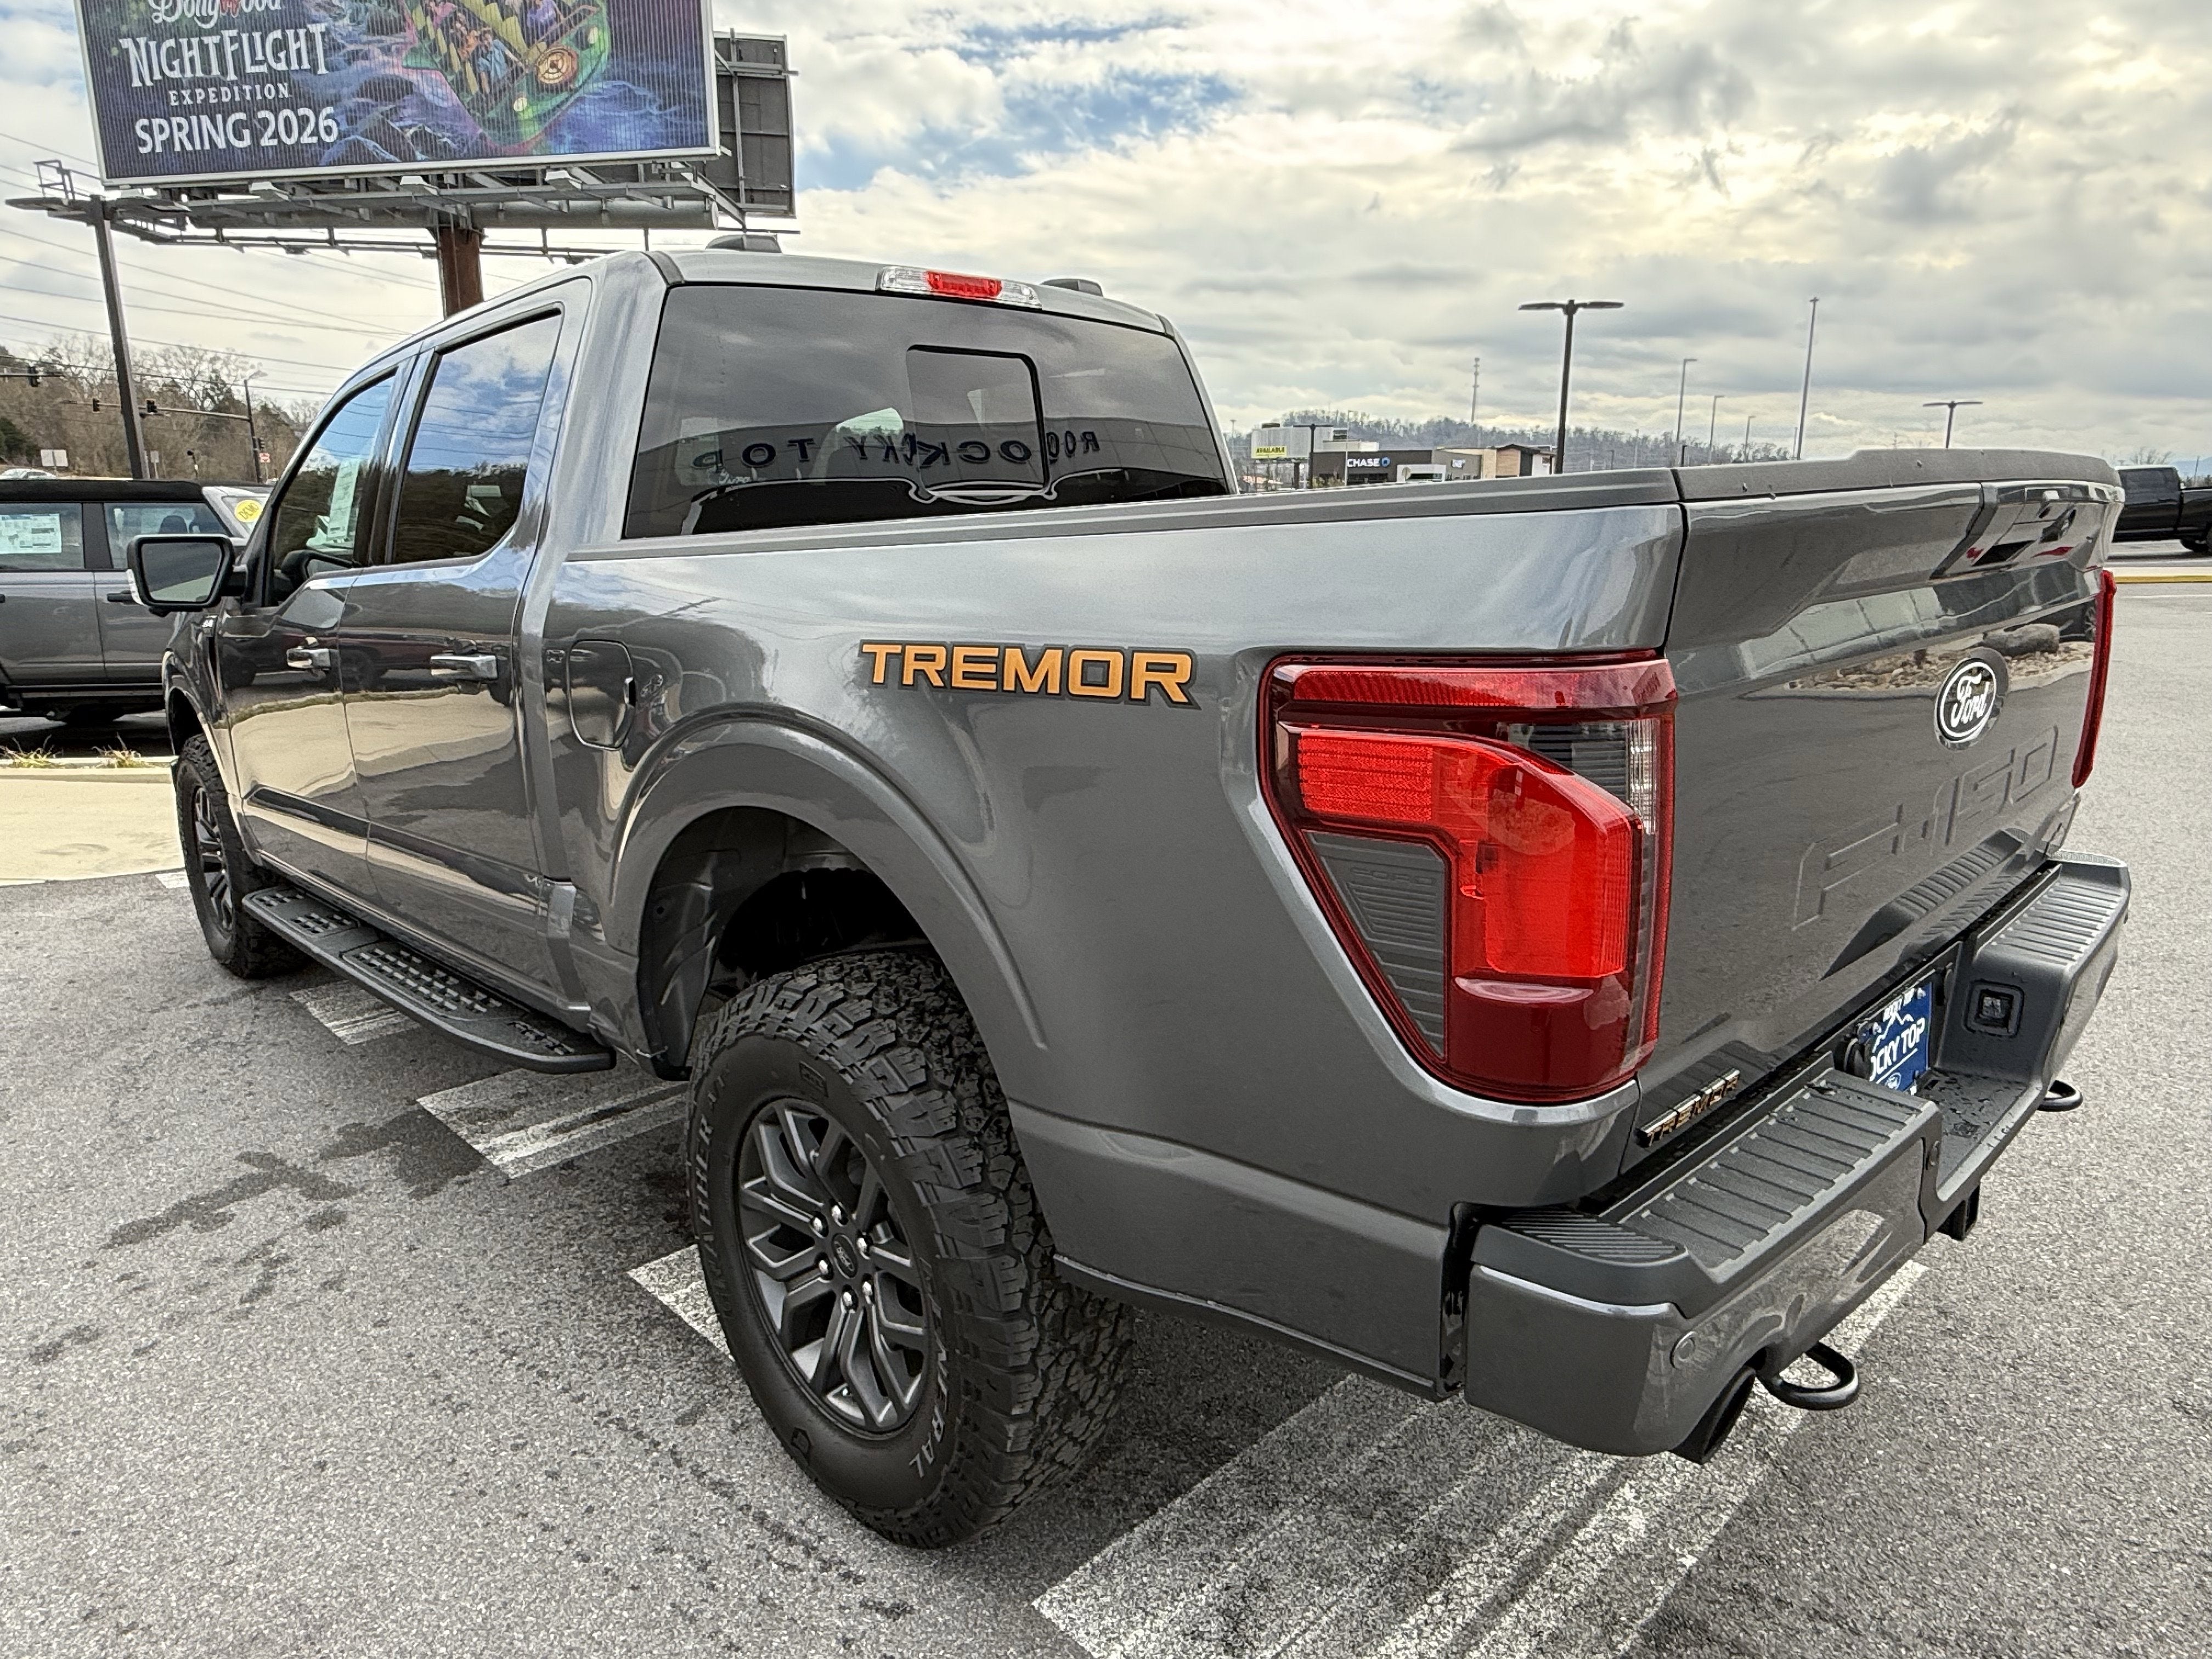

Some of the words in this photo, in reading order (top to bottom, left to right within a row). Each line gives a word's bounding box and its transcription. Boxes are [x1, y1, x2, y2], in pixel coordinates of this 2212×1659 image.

[119, 22, 330, 87] NIGHTFLIGHT
[169, 83, 290, 106] EXPEDITION
[135, 114, 251, 154] SPRING
[259, 106, 339, 148] 2026
[1347, 459, 1380, 467] CHASE
[860, 641, 1198, 707] TREMOR
[1951, 673, 1990, 727] Ford
[1870, 1036, 1900, 1082] OCKY
[1901, 1017, 1926, 1054] TOP
